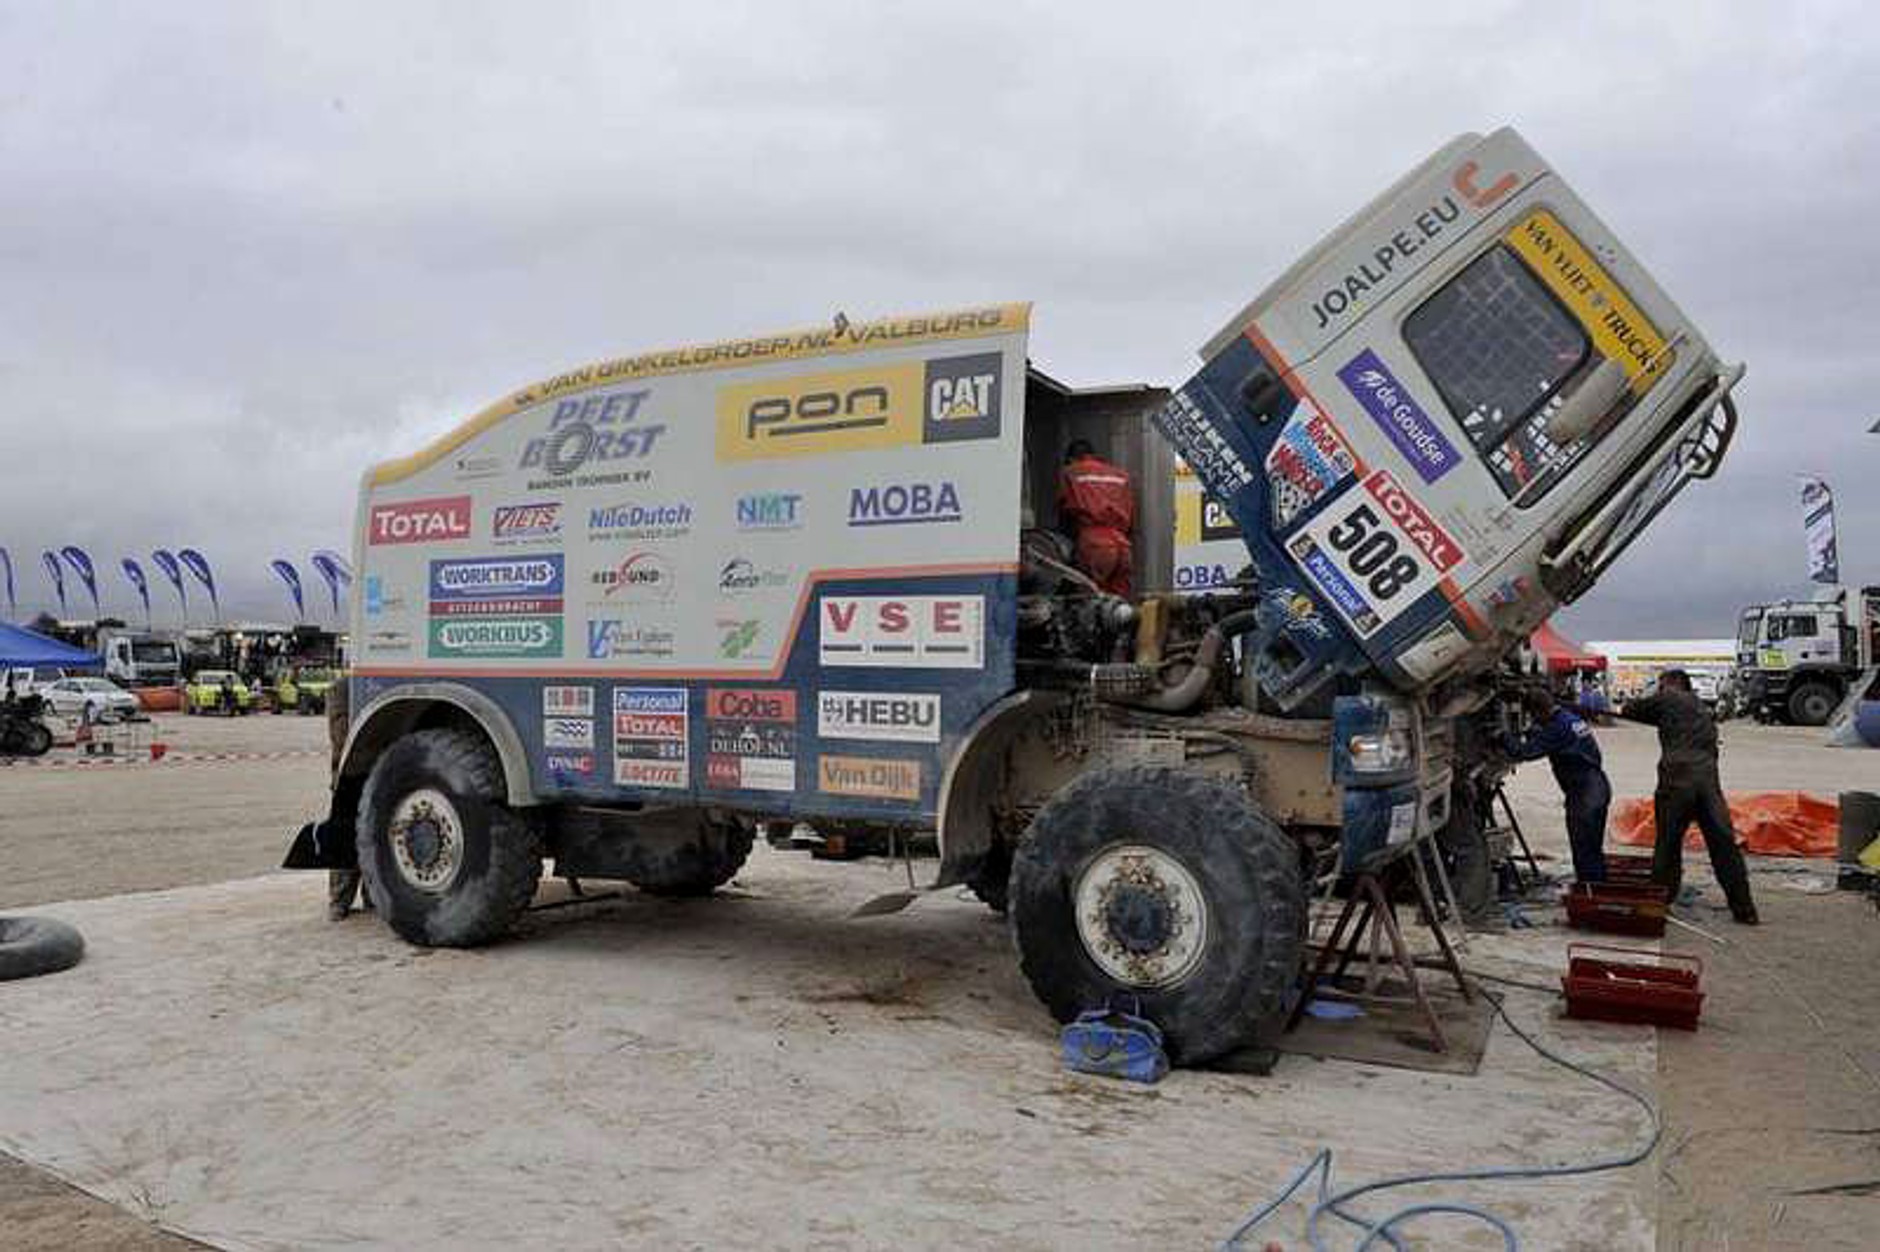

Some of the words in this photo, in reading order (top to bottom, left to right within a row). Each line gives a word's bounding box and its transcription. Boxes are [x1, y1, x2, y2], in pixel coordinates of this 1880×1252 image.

[1312, 197, 1460, 328] JOALPE.EU
[850, 310, 1001, 343] VALBURG
[1603, 309, 1663, 376] TRUCKS
[551, 389, 653, 428] PEET
[747, 387, 887, 439] pon
[931, 374, 995, 421] CAT
[1377, 387, 1397, 409] de
[737, 495, 802, 524] NMT
[850, 482, 960, 518] MOBA
[376, 510, 465, 537] TOTAL
[1375, 476, 1449, 572] TOTAL
[1328, 503, 1419, 600] 508
[444, 563, 548, 584] WORKTRANS
[1174, 564, 1225, 586] OBA
[620, 716, 682, 735] TOTAL
[846, 699, 935, 726] HEBU
